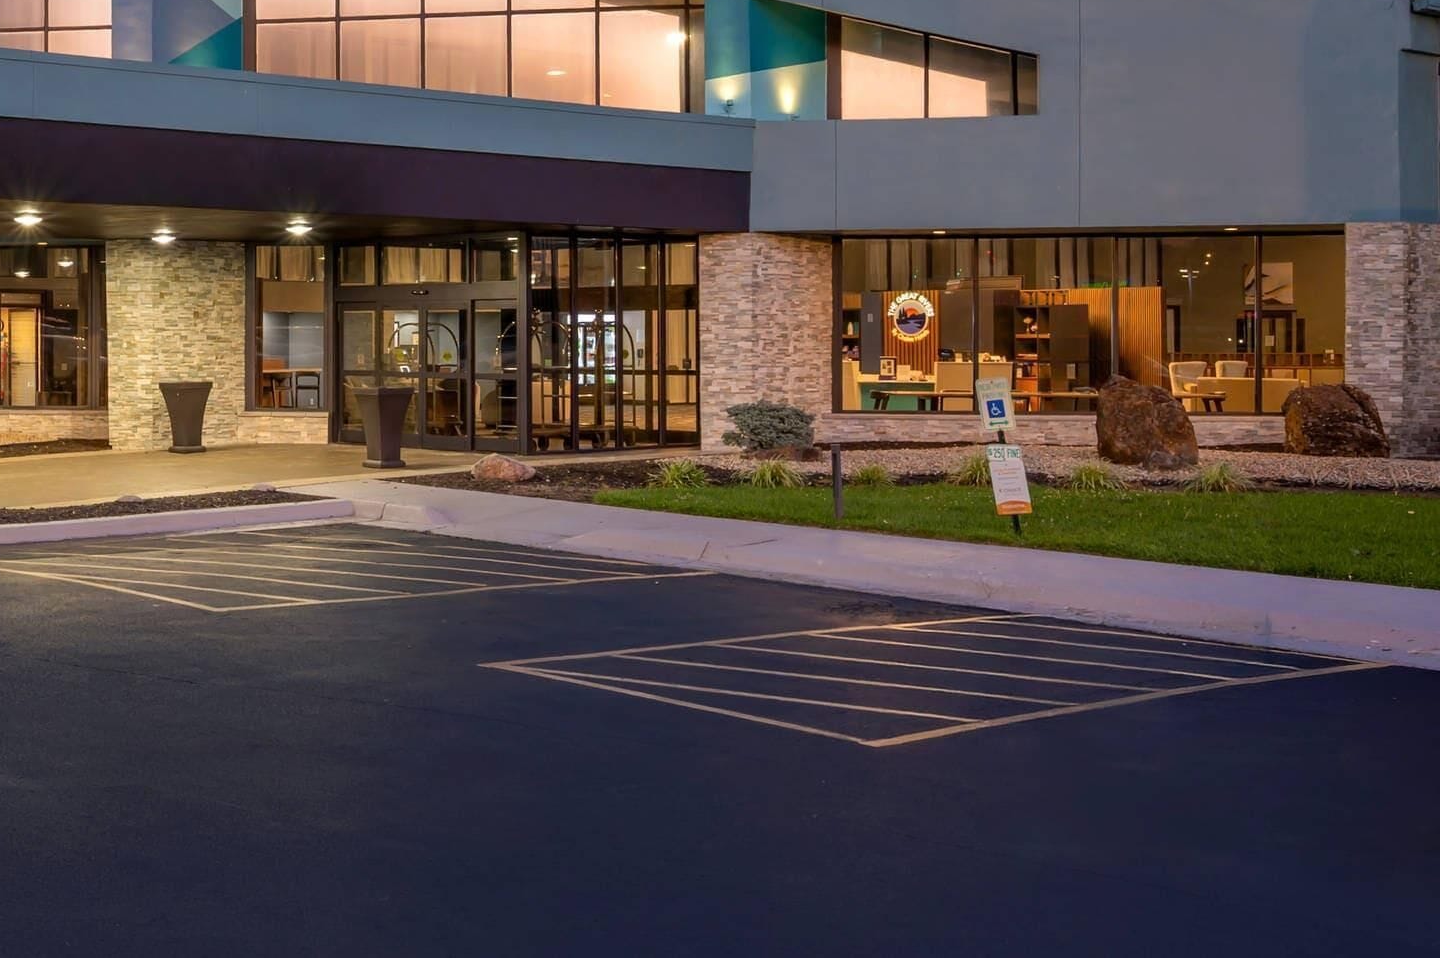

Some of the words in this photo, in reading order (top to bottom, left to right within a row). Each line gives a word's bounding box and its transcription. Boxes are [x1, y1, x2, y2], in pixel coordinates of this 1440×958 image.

[888, 301, 898, 316] THE
[896, 292, 919, 303] GREAT
[918, 295, 935, 317] RIVERS
[1007, 448, 1021, 459] FINE
